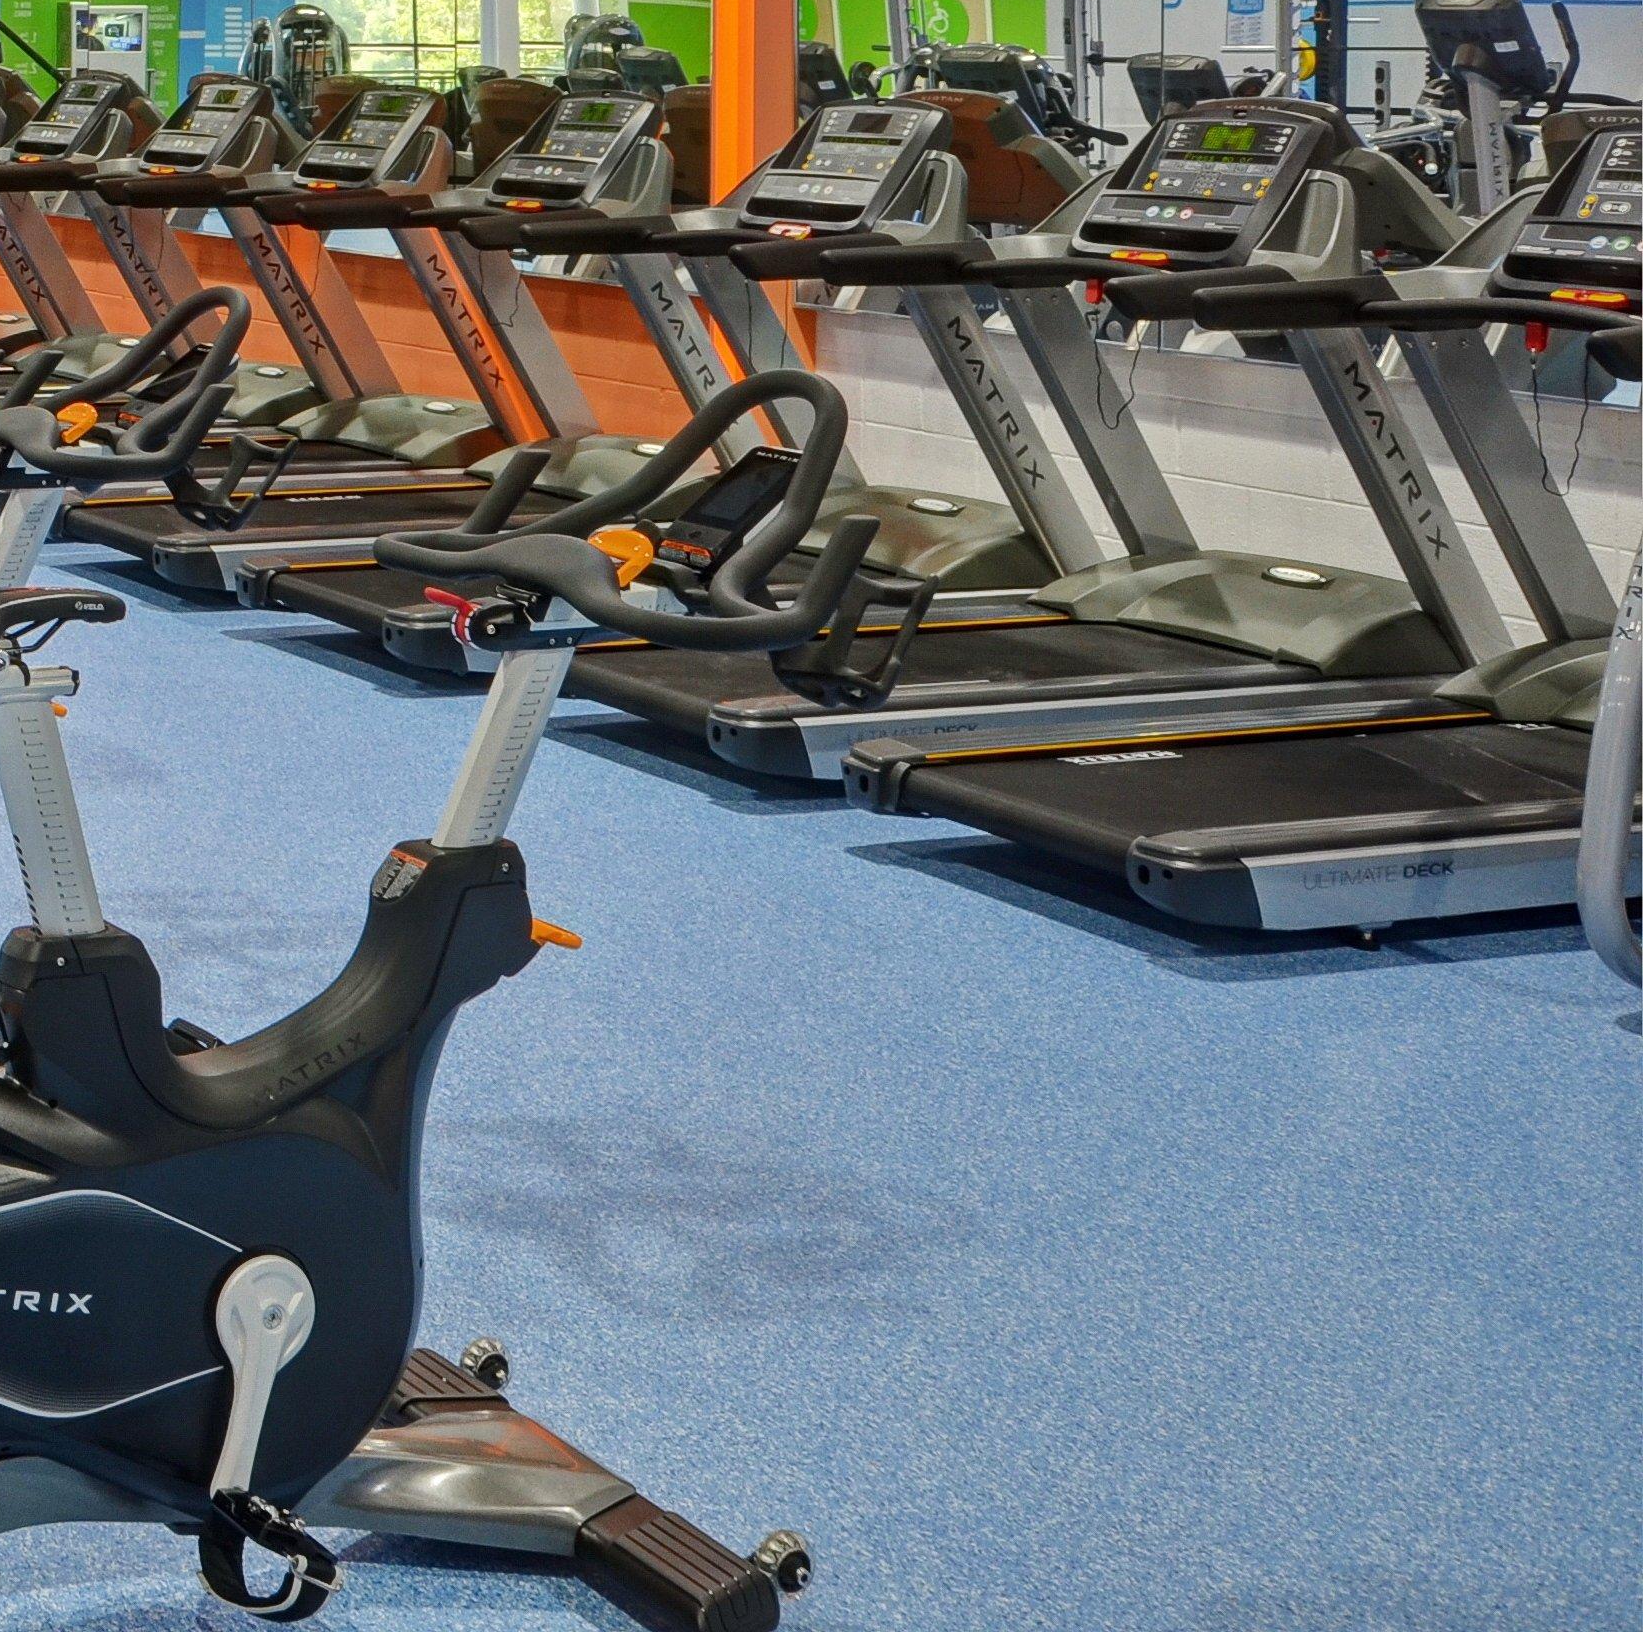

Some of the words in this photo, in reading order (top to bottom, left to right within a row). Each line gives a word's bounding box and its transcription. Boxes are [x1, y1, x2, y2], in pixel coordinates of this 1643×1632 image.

[253, 232, 327, 354] MATRIX
[426, 254, 505, 390] MATRIX
[649, 280, 717, 392] MATR
[947, 316, 1045, 489] MATRIX
[1343, 360, 1450, 561] MATRIX
[1302, 866, 1398, 891] ULTIMATE
[1401, 859, 1456, 881] DECK
[253, 1029, 369, 1106] MATRIX
